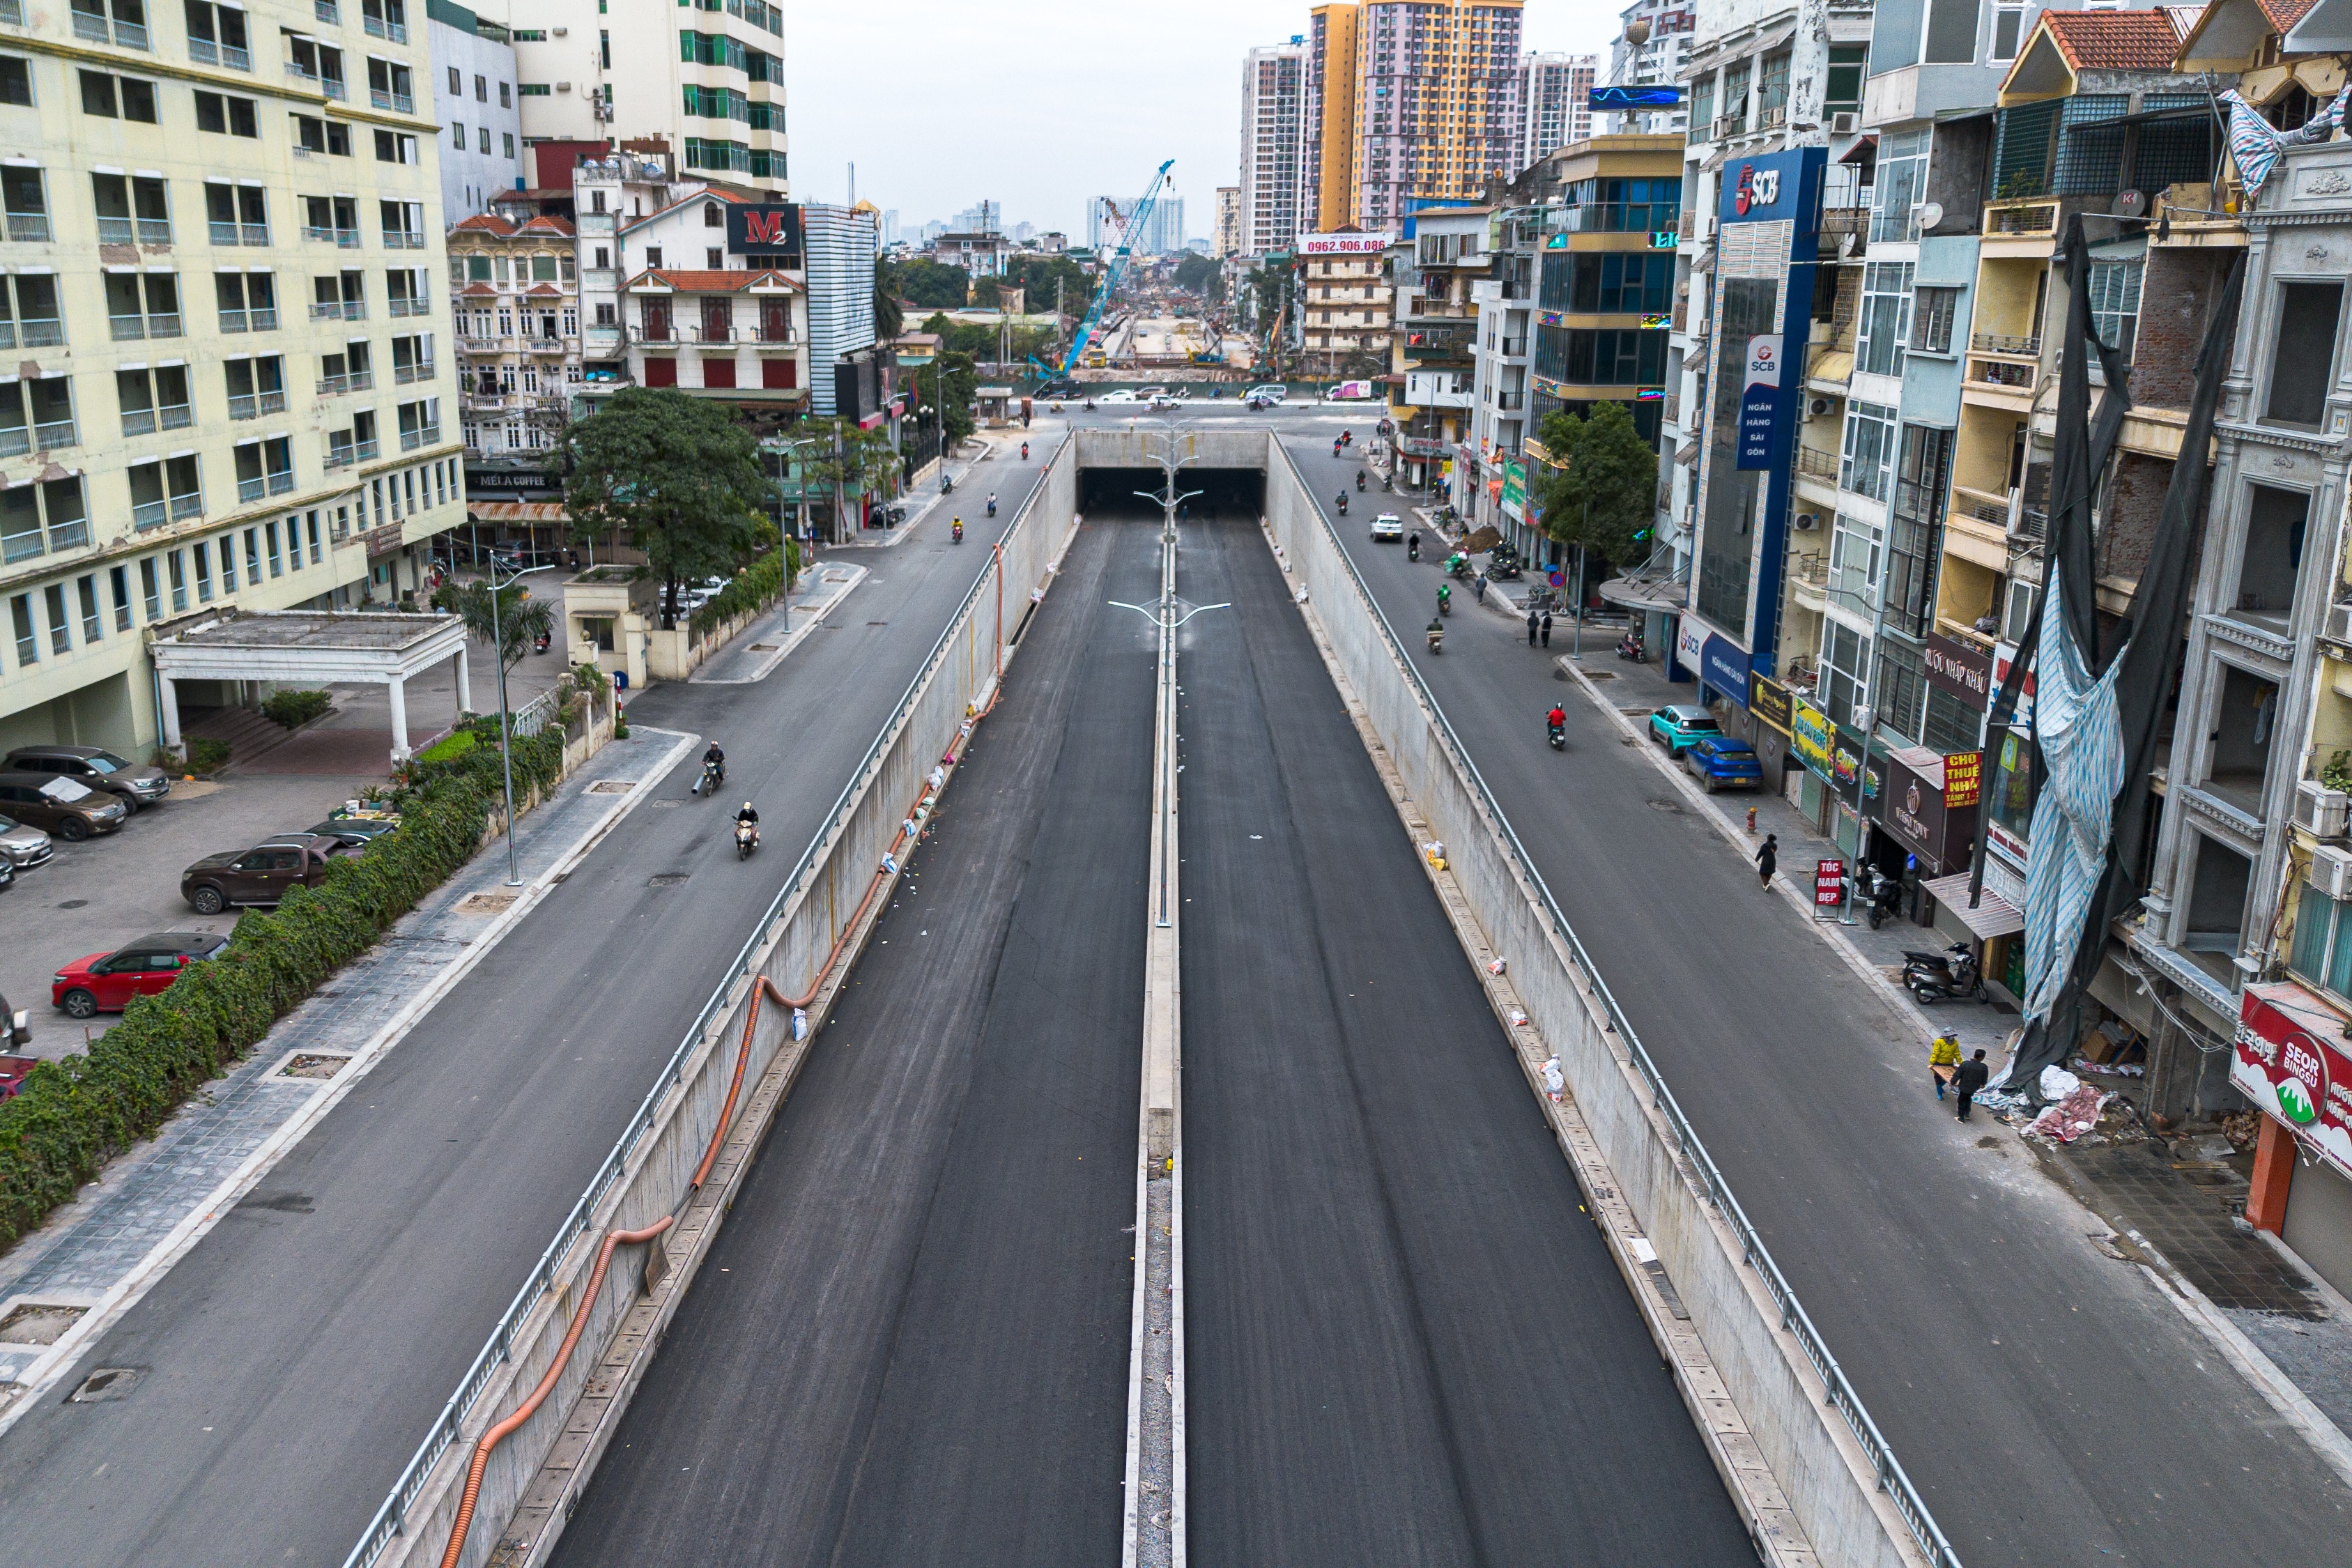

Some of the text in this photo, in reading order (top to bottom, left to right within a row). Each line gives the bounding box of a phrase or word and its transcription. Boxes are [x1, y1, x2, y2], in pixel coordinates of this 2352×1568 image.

[1751, 170, 1779, 205] SCB
[1308, 240, 1385, 252] 0962.906.086
[1751, 362, 1775, 371] SCB
[1748, 403, 1771, 411] NGÂN
[1750, 432, 1765, 441] SÀI
[1747, 447, 1765, 456] GÒN
[514, 476, 545, 486] COFFEE
[1687, 635, 1699, 656] SCB
[1925, 649, 1946, 674] RƯỢU
[1949, 753, 1977, 766] CHO
[1946, 764, 1979, 779] THUÊ
[1949, 778, 1978, 792] NHÀ
[1821, 861, 1839, 872] TÓC
[1817, 878, 1840, 887] NAM
[1818, 893, 1837, 904] ĐẸP
[2286, 1042, 2319, 1077] SEOR
[2283, 1056, 2317, 1088] BINGSU
